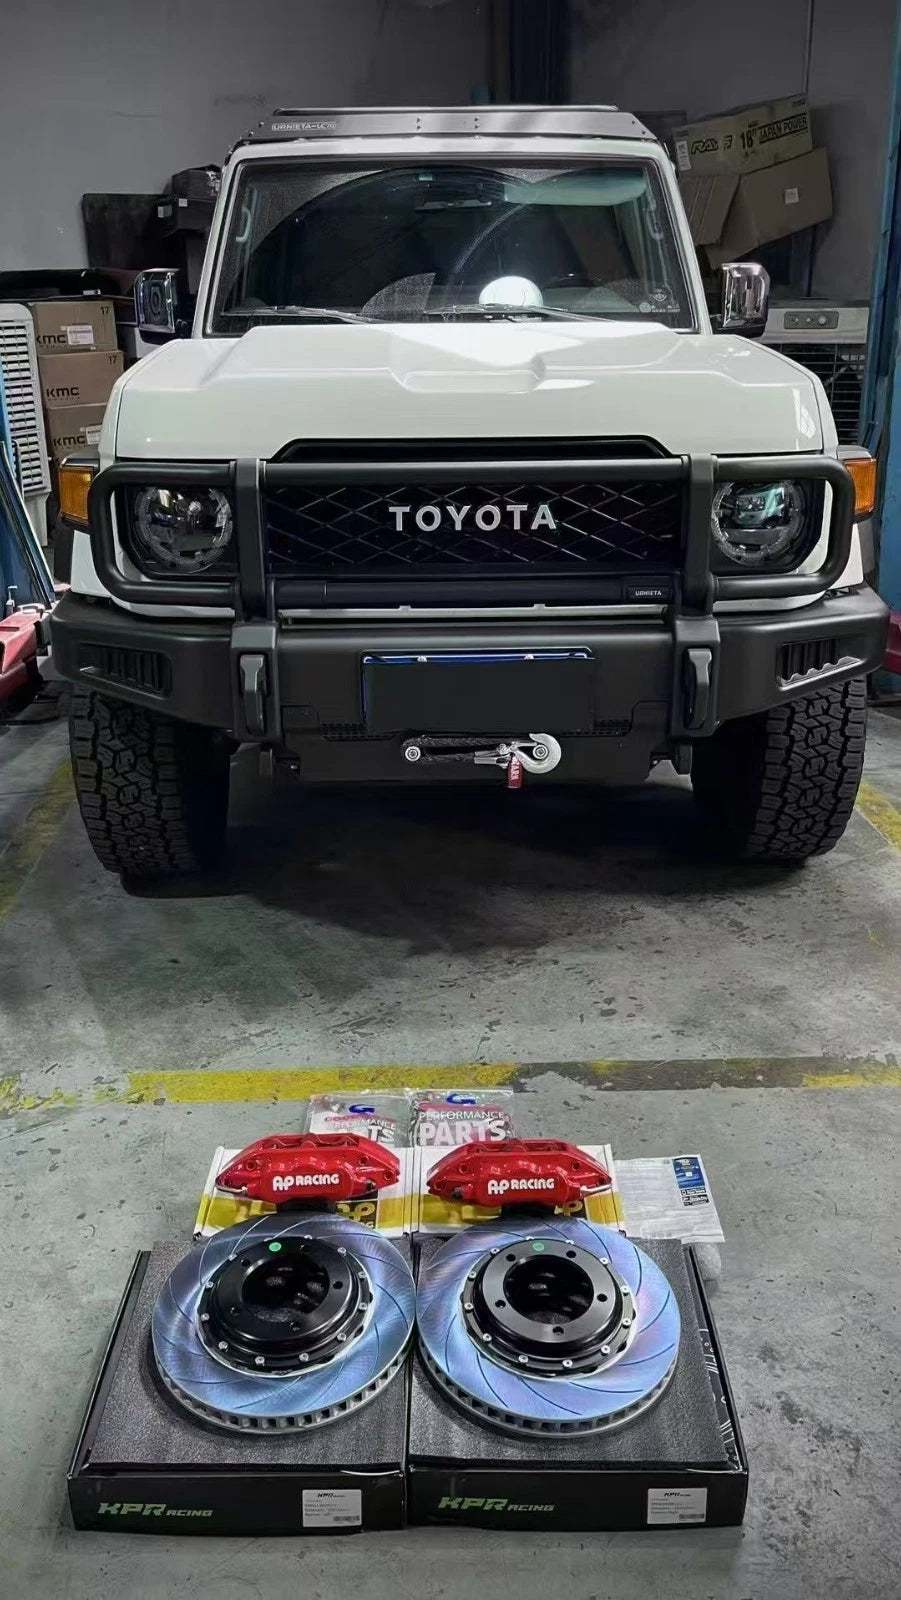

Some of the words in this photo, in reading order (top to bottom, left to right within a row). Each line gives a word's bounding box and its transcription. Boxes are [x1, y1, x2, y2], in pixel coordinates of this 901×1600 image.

[759, 124, 782, 140] JAPAN
[783, 116, 807, 132] POWER
[101, 307, 109, 315] 17
[108, 355, 117, 364] 17
[388, 504, 557, 532] TOYOTA
[418, 1110, 504, 1121] PERFORMANCE
[419, 1118, 506, 1146] PARTS
[295, 1173, 340, 1186] RACING
[511, 1178, 555, 1190] RACING
